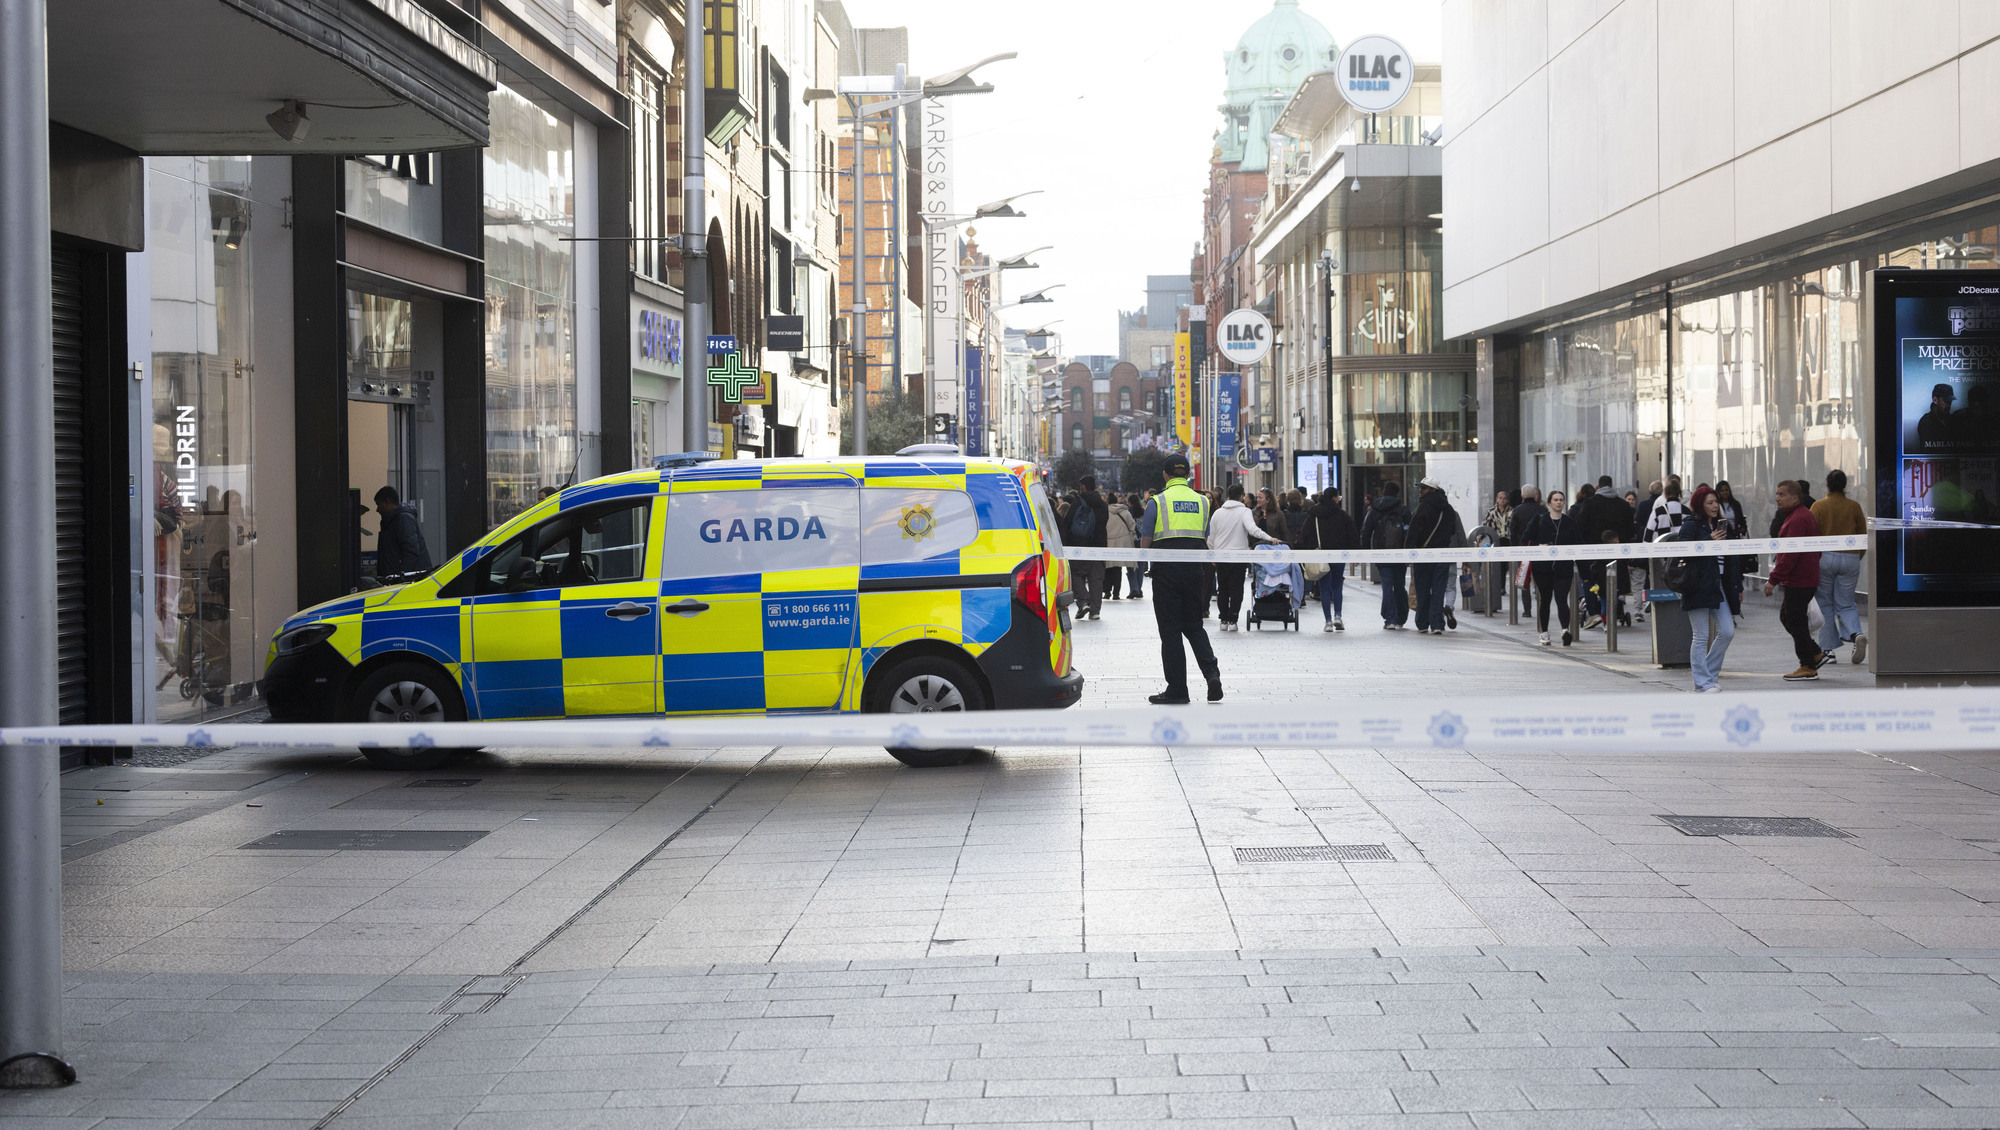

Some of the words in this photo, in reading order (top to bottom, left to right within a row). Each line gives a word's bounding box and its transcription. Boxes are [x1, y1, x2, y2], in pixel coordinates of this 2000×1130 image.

[1349, 54, 1402, 79] ILAC
[1349, 80, 1390, 91] DUBLIN
[927, 96, 946, 174] MARKS
[927, 180, 946, 195] &
[1958, 286, 2000, 294] JCDecaux
[1950, 302, 2000, 319] marla
[1227, 324, 1264, 341] ILAC
[1227, 342, 1256, 350] DUBLIN
[1918, 345, 1990, 358] MUMFORD
[1932, 358, 2000, 370] PRIZEFIGH
[1179, 345, 1187, 425] TOYMASTER
[935, 391, 949, 401] &S
[968, 370, 976, 449] JERVIS
[1354, 436, 1375, 449] oot
[1924, 440, 1954, 448] MARLAY
[176, 405, 196, 512] HILDREN
[1174, 503, 1198, 511] GARDA
[1910, 505, 1935, 513] Sunday
[700, 515, 827, 543] GARDA
[783, 606, 789, 614] 1
[792, 604, 810, 613] 800
[812, 604, 830, 613] 666
[833, 603, 850, 612] 111
[768, 615, 850, 629] www.garda.ie
